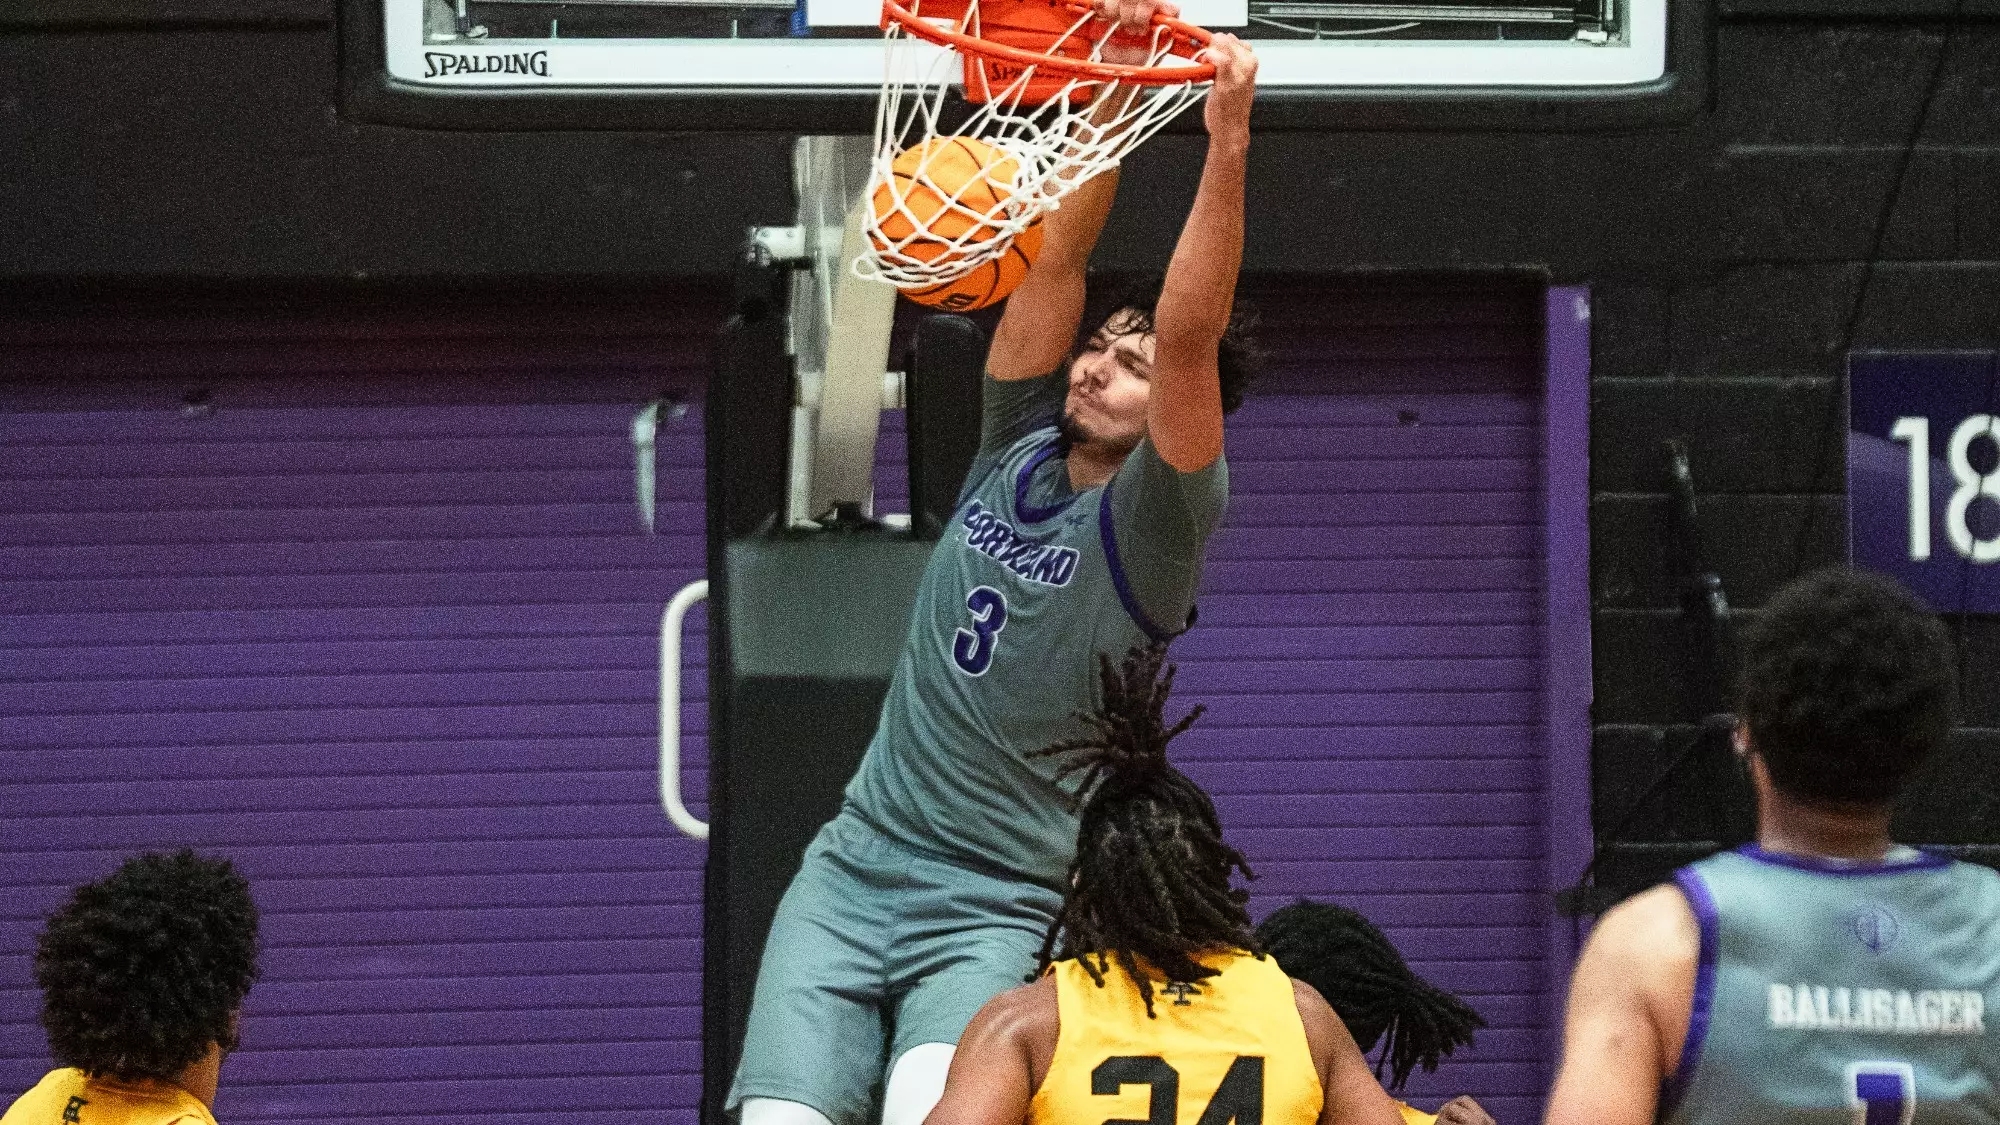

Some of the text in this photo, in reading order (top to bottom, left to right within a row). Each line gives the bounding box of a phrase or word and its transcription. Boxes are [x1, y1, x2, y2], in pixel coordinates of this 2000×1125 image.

[424, 50, 549, 79] SPALDING
[1891, 413, 2000, 564] 18
[953, 585, 1008, 677] 3
[1767, 982, 1985, 1035] BALLISAGER
